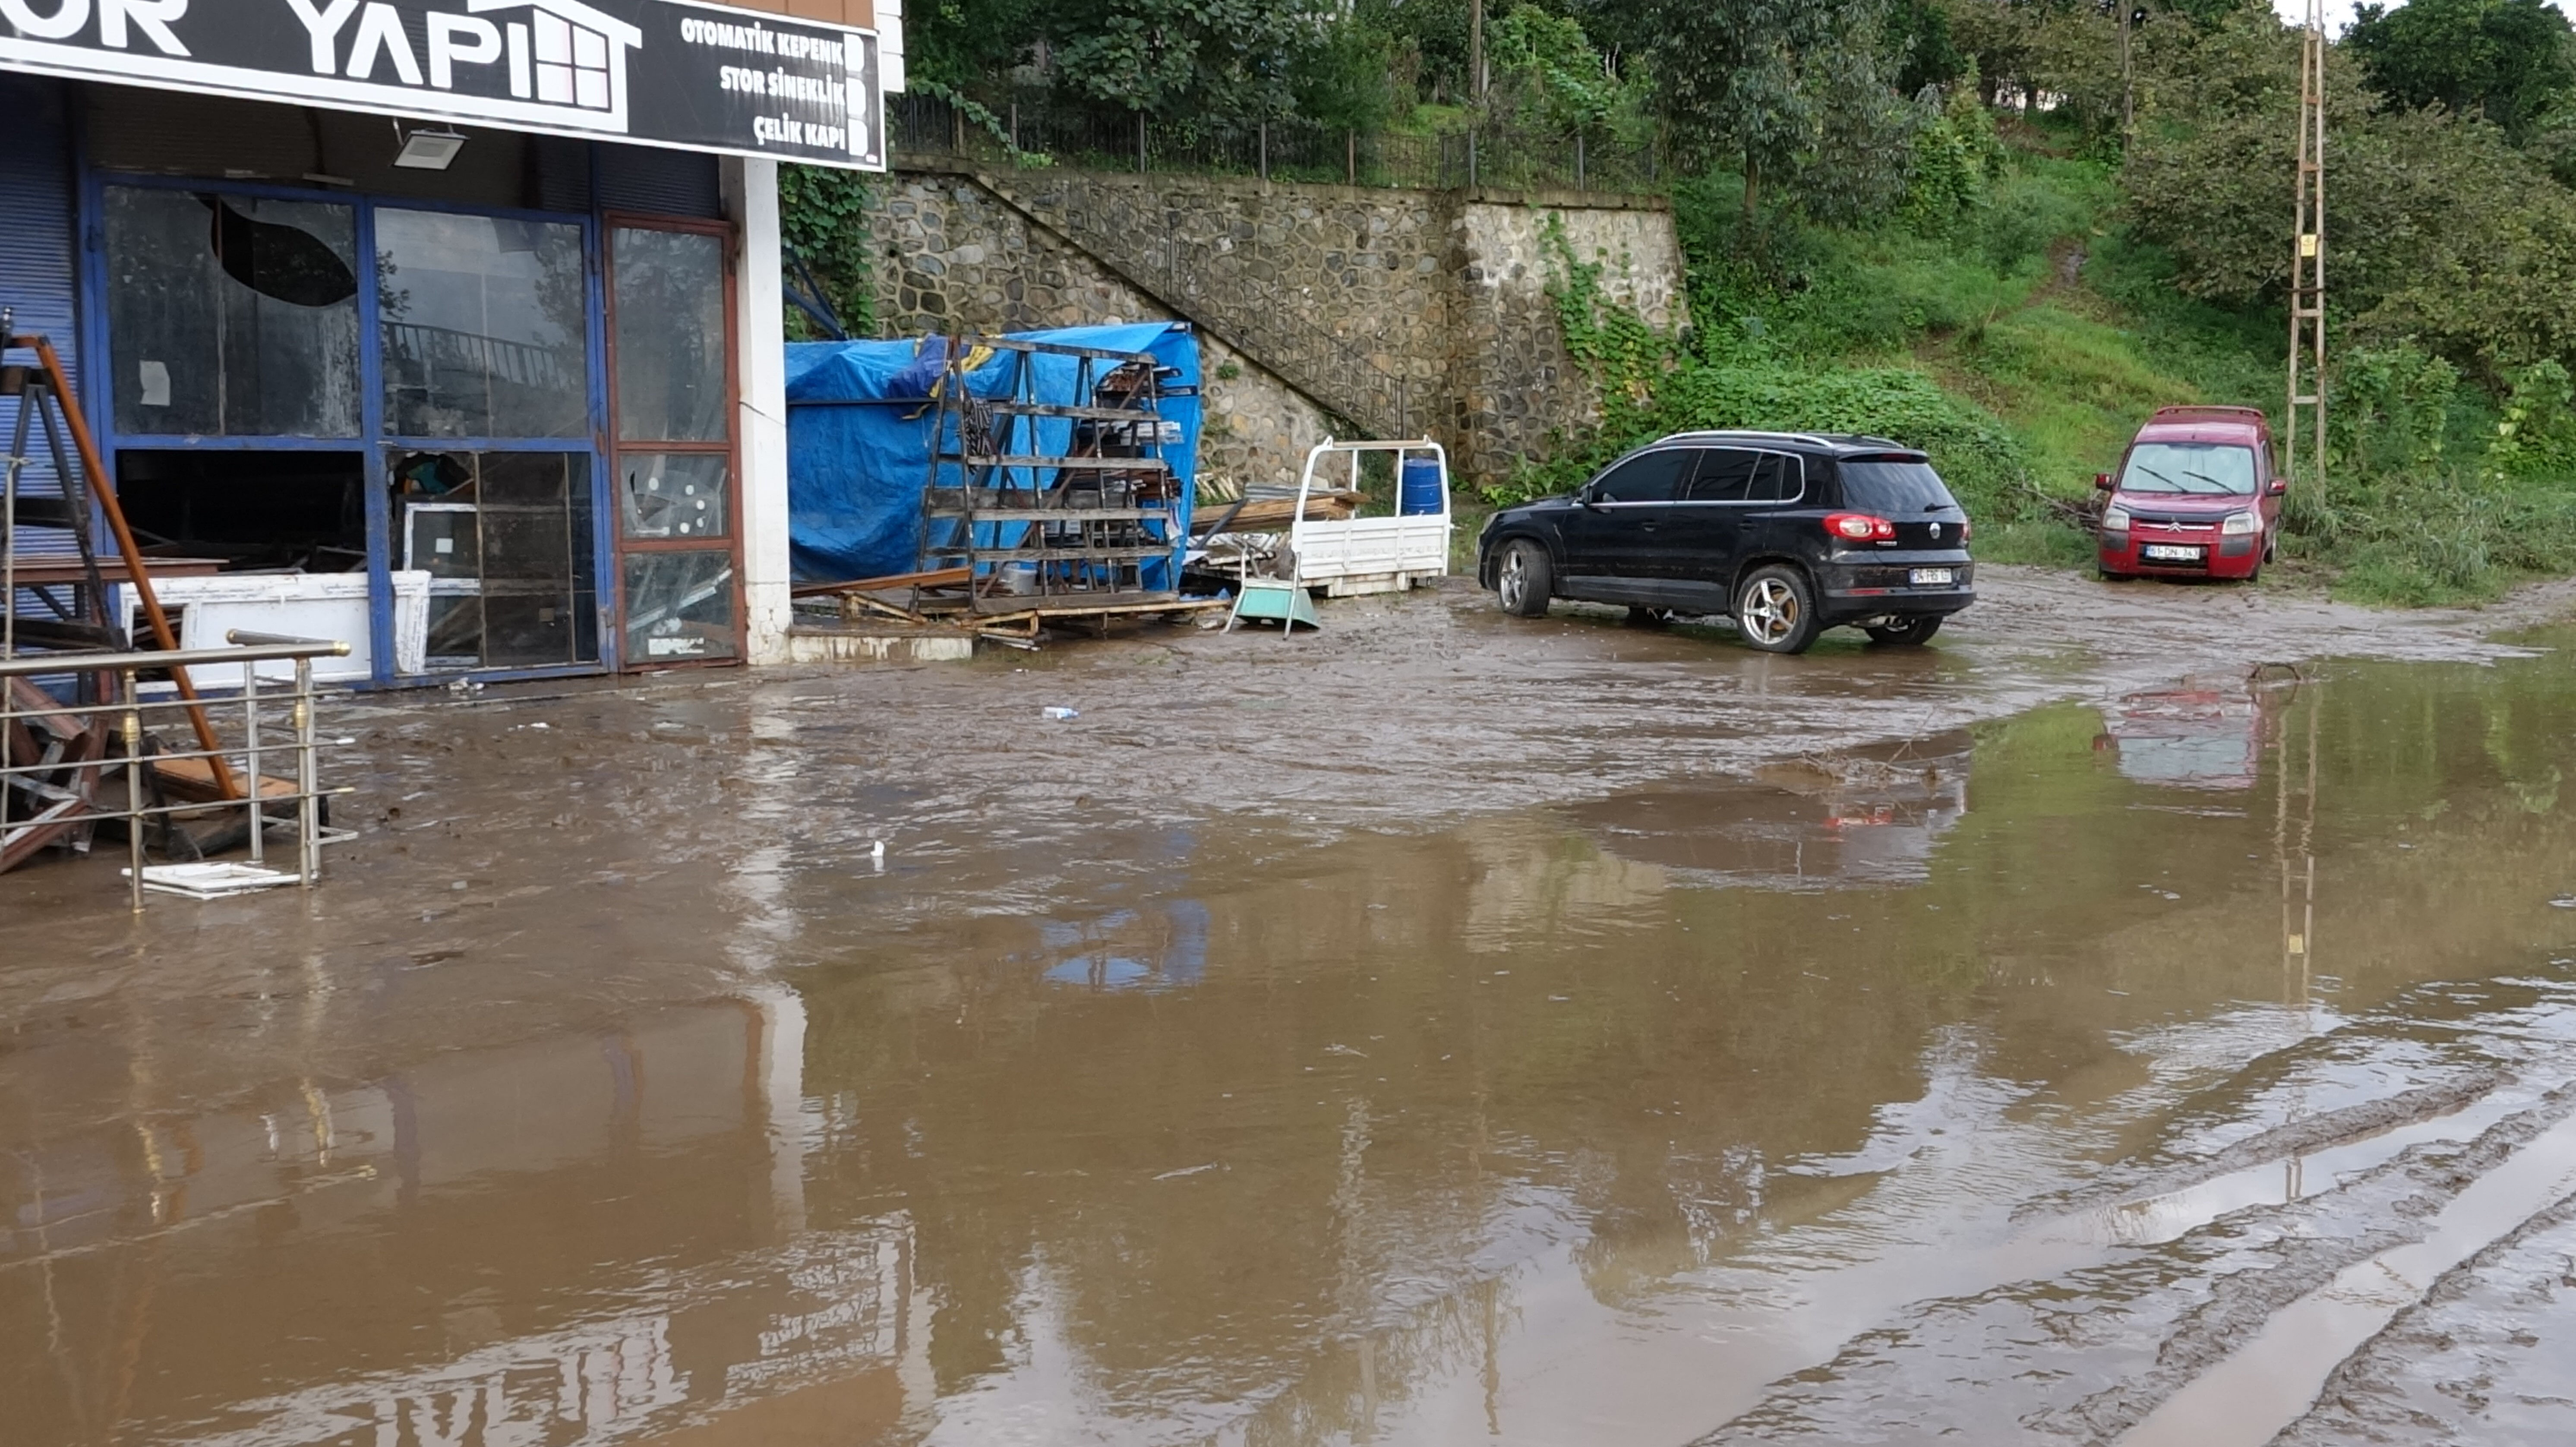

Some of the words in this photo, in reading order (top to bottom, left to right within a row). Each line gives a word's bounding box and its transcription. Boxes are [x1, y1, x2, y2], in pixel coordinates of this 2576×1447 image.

[285, 0, 531, 98] YAPI
[681, 18, 775, 54] OTOMATİK
[777, 33, 844, 65] KEPENK
[720, 66, 766, 94] STOR
[768, 67, 846, 106] SİNEKLİK
[754, 113, 803, 146] ÇELİK
[805, 123, 846, 150] KAPI
